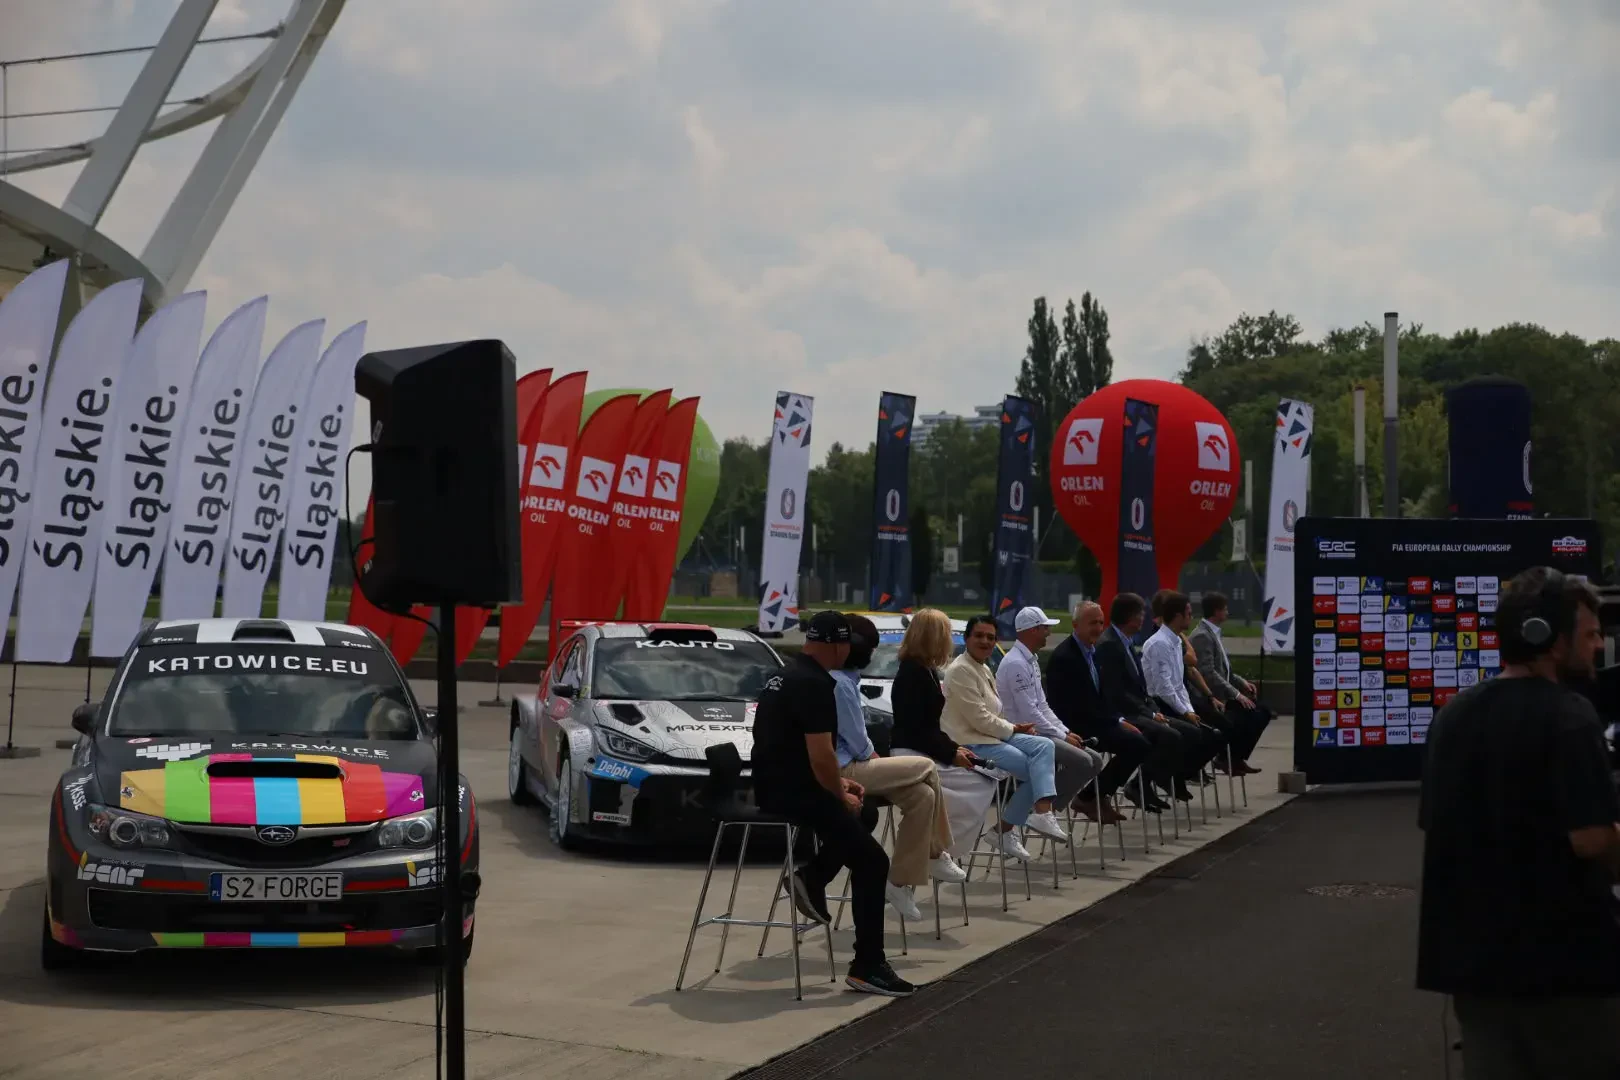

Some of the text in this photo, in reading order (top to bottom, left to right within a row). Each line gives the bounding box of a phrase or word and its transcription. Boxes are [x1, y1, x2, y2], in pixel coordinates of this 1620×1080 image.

[33, 377, 113, 572] Śląskie.
[105, 384, 179, 570] Śląskie.
[174, 387, 243, 567] Śląskie.
[232, 404, 298, 574] Śląskie.
[288, 404, 344, 569] Śląskie.
[1061, 475, 1104, 492] ORLEN
[1189, 479, 1232, 498] ORLEN
[1073, 495, 1091, 507] OIL
[1200, 499, 1216, 511] OIL
[530, 512, 548, 524] OIL
[567, 504, 611, 526] ORLEN
[649, 505, 680, 522] RLEN
[578, 523, 595, 536] OIL
[616, 518, 632, 529] OIL
[649, 521, 665, 533] OIL
[1392, 544, 1512, 552] FIA EUROPEAN RALLY CHAMPIONSHIP
[635, 640, 735, 650] KAJTO
[148, 654, 369, 675] KATOWICE.EU
[666, 725, 706, 733] MAX
[231, 742, 389, 757] KATOWICE
[597, 759, 634, 778] Delphi
[226, 876, 339, 898] S2 FORGE
